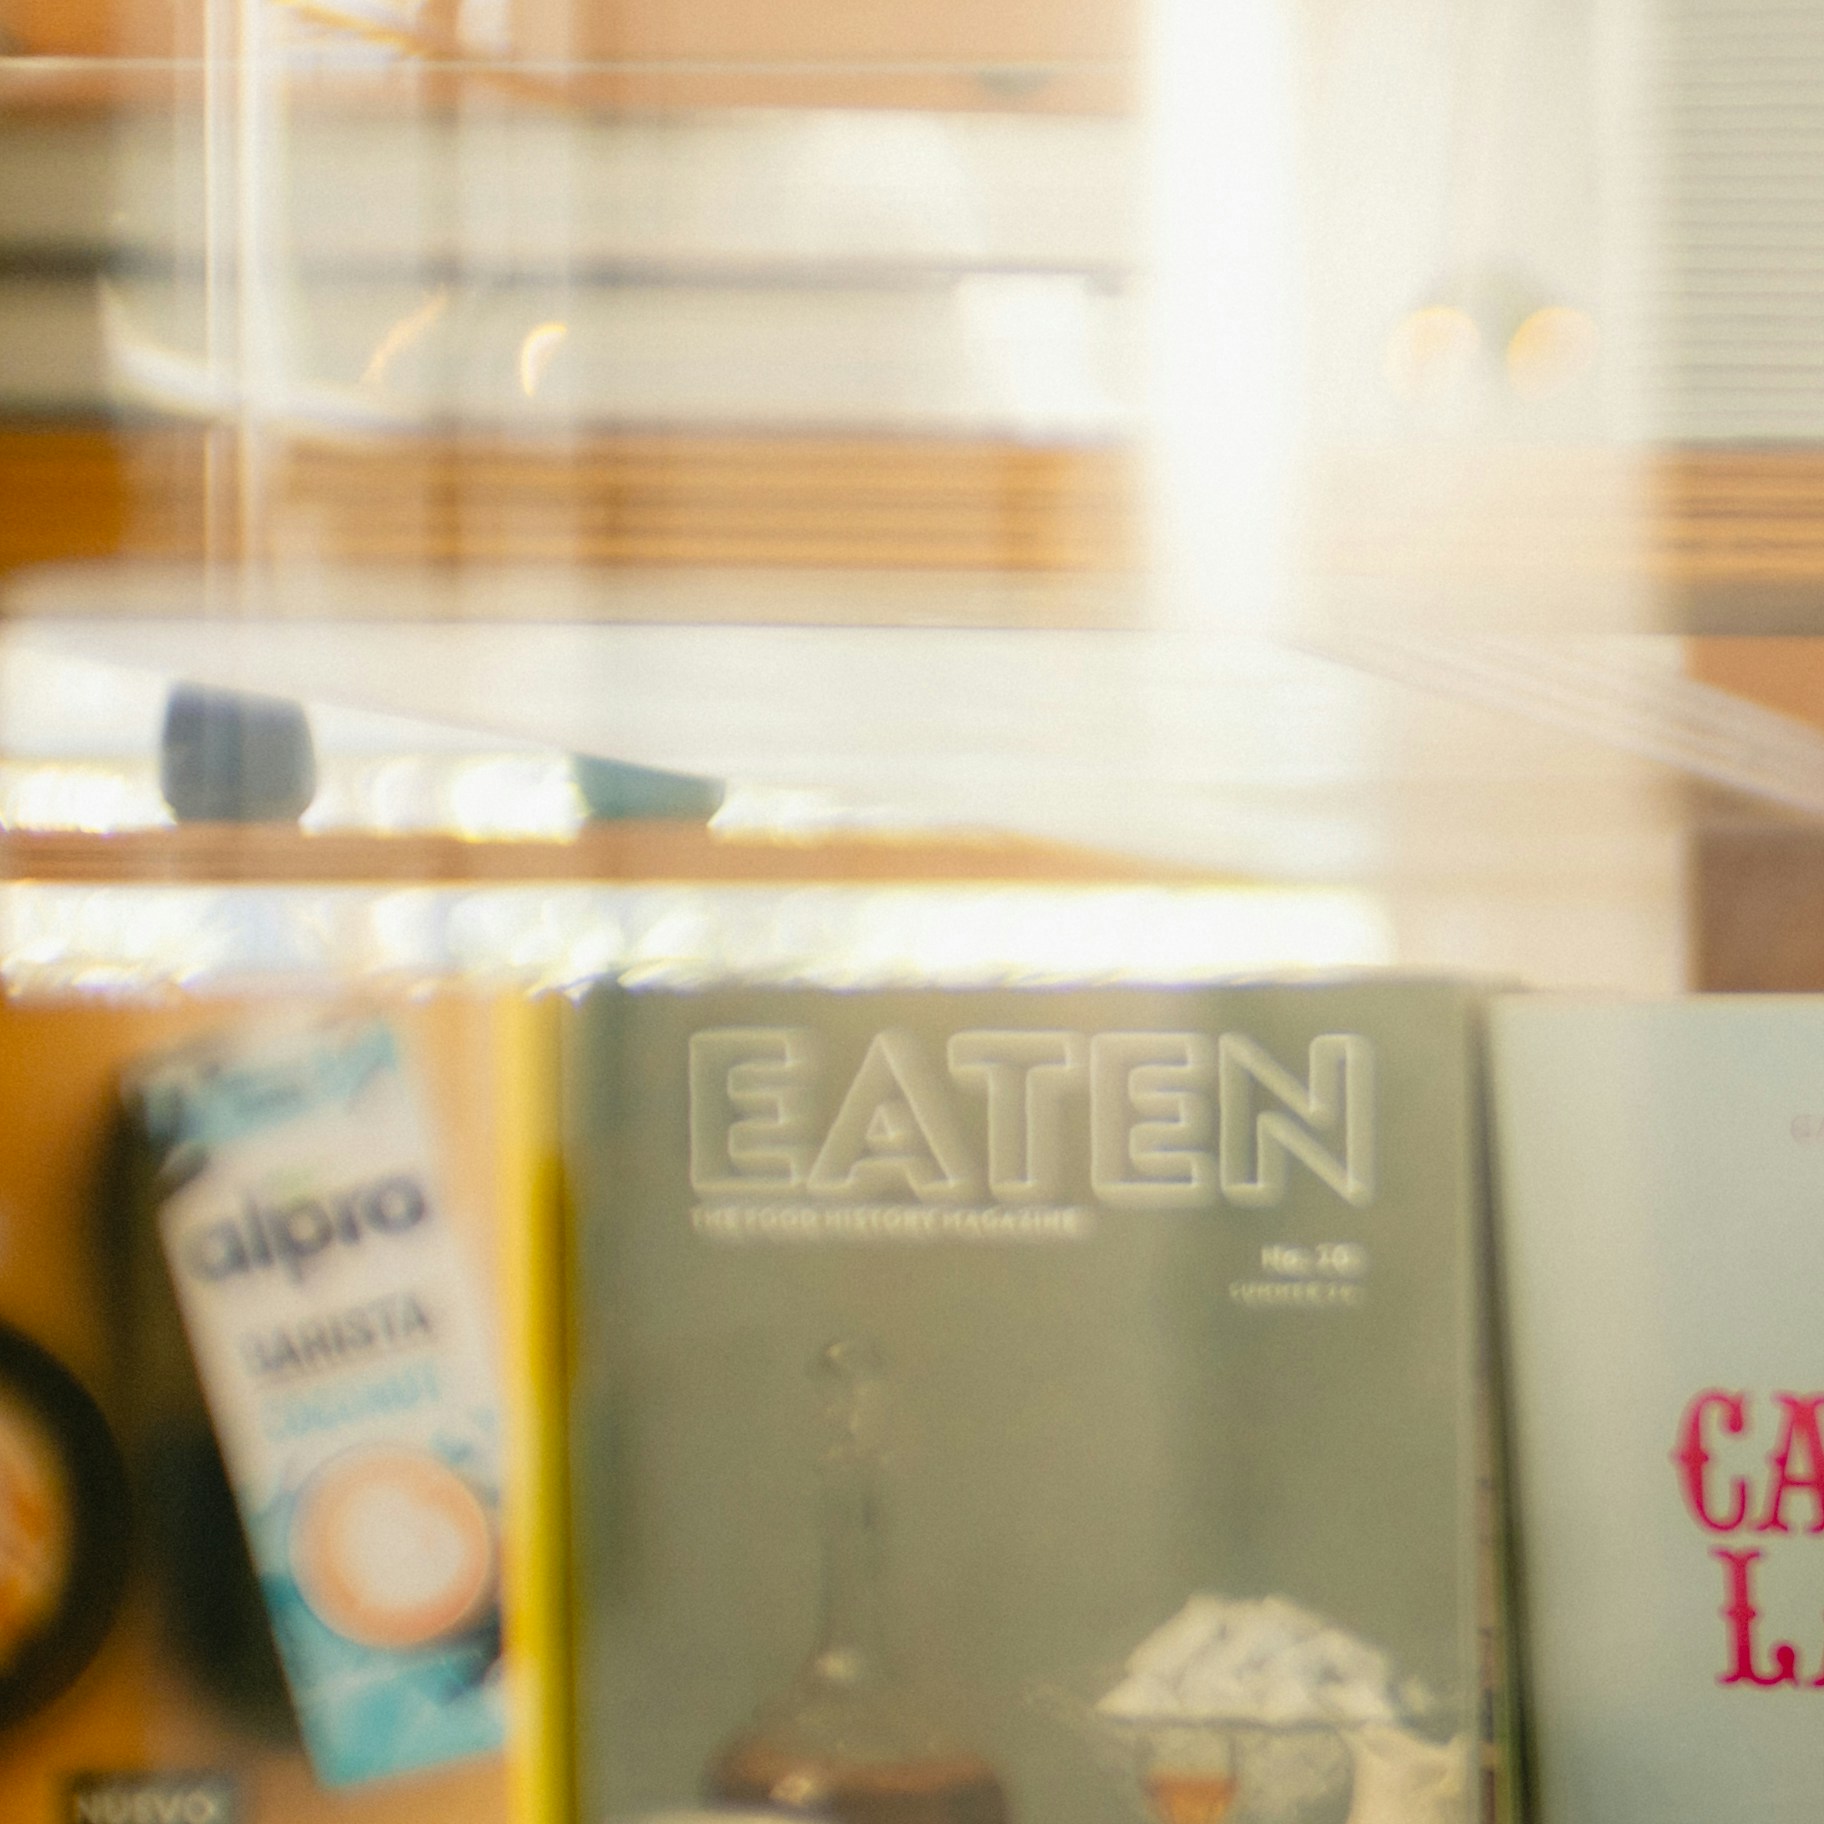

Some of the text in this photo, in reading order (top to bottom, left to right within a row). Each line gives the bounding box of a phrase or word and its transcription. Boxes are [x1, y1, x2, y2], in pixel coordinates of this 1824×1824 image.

[690, 1028, 1376, 1203] EATEN
[186, 1172, 428, 1285] alpro
[745, 1207, 817, 1231] FOOD
[825, 1207, 938, 1231] HISTORY
[942, 1207, 1077, 1231] MAGAZINE
